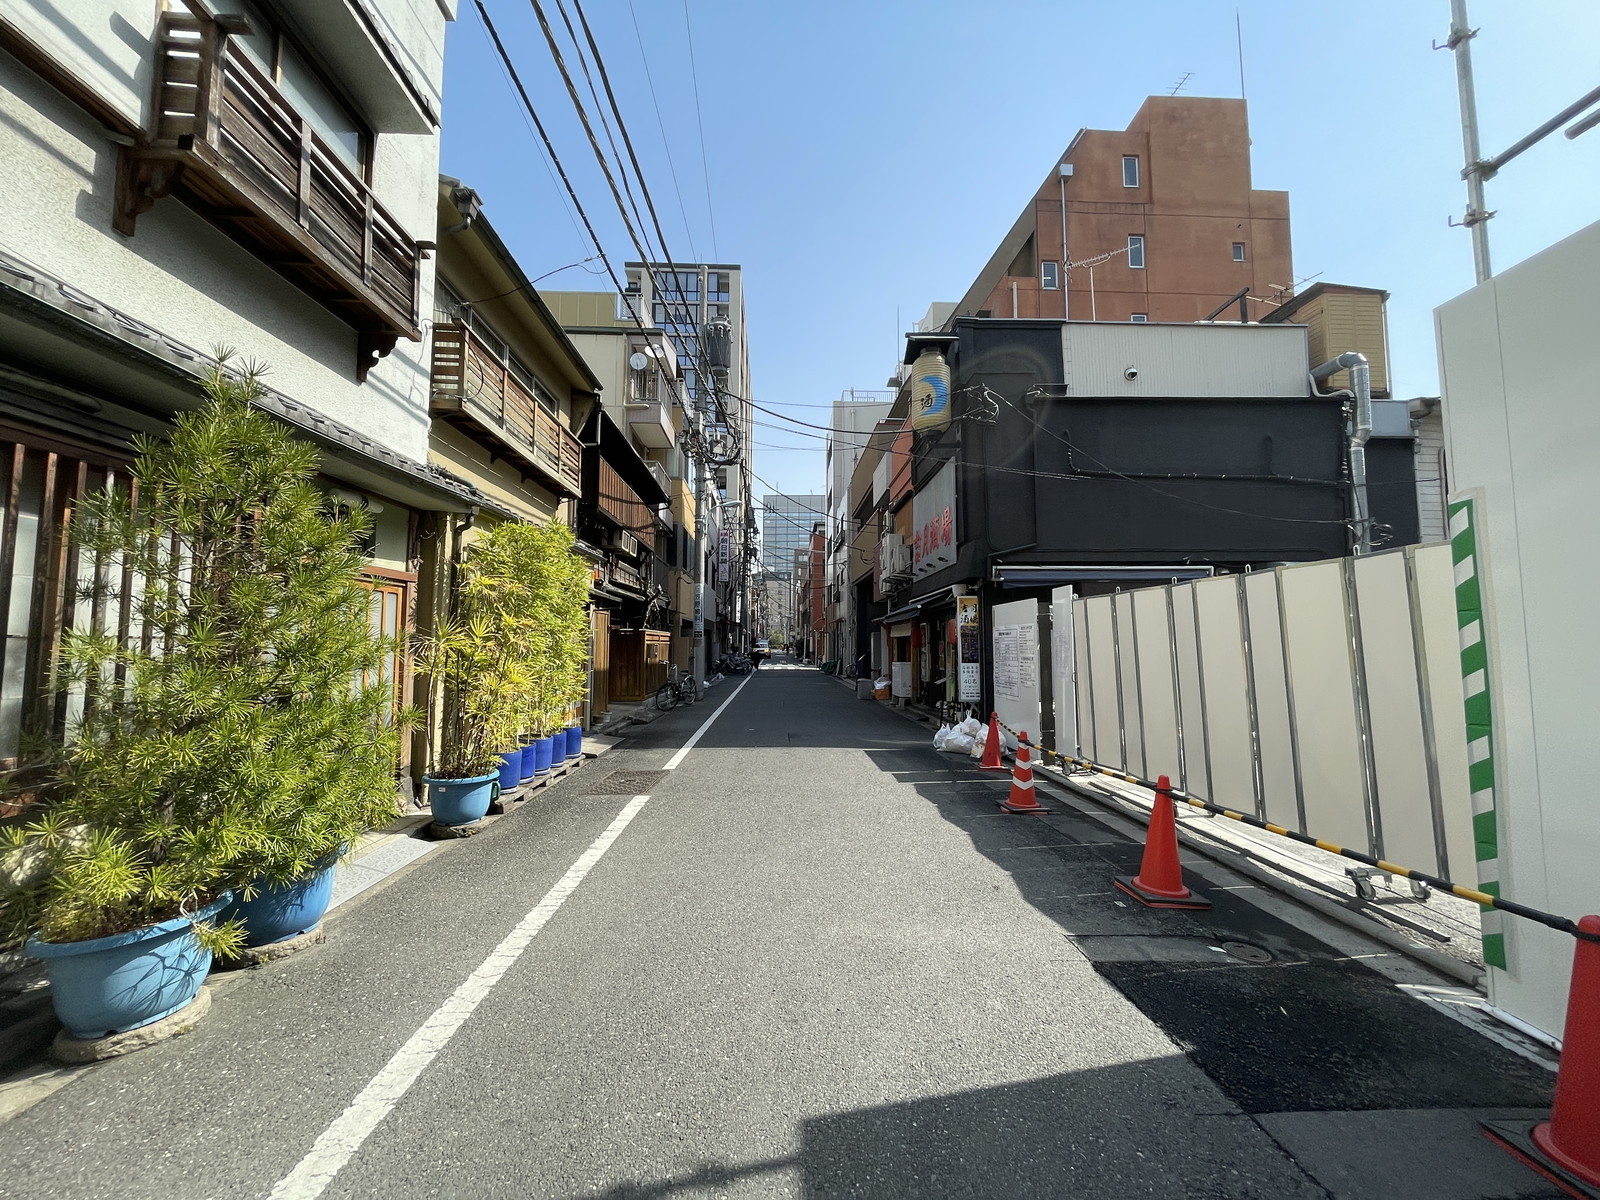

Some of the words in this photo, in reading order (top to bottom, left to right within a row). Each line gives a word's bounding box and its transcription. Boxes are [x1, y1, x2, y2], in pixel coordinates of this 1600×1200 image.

[920, 393, 933, 410] 酒
[914, 505, 953, 564] 吉月酒場
